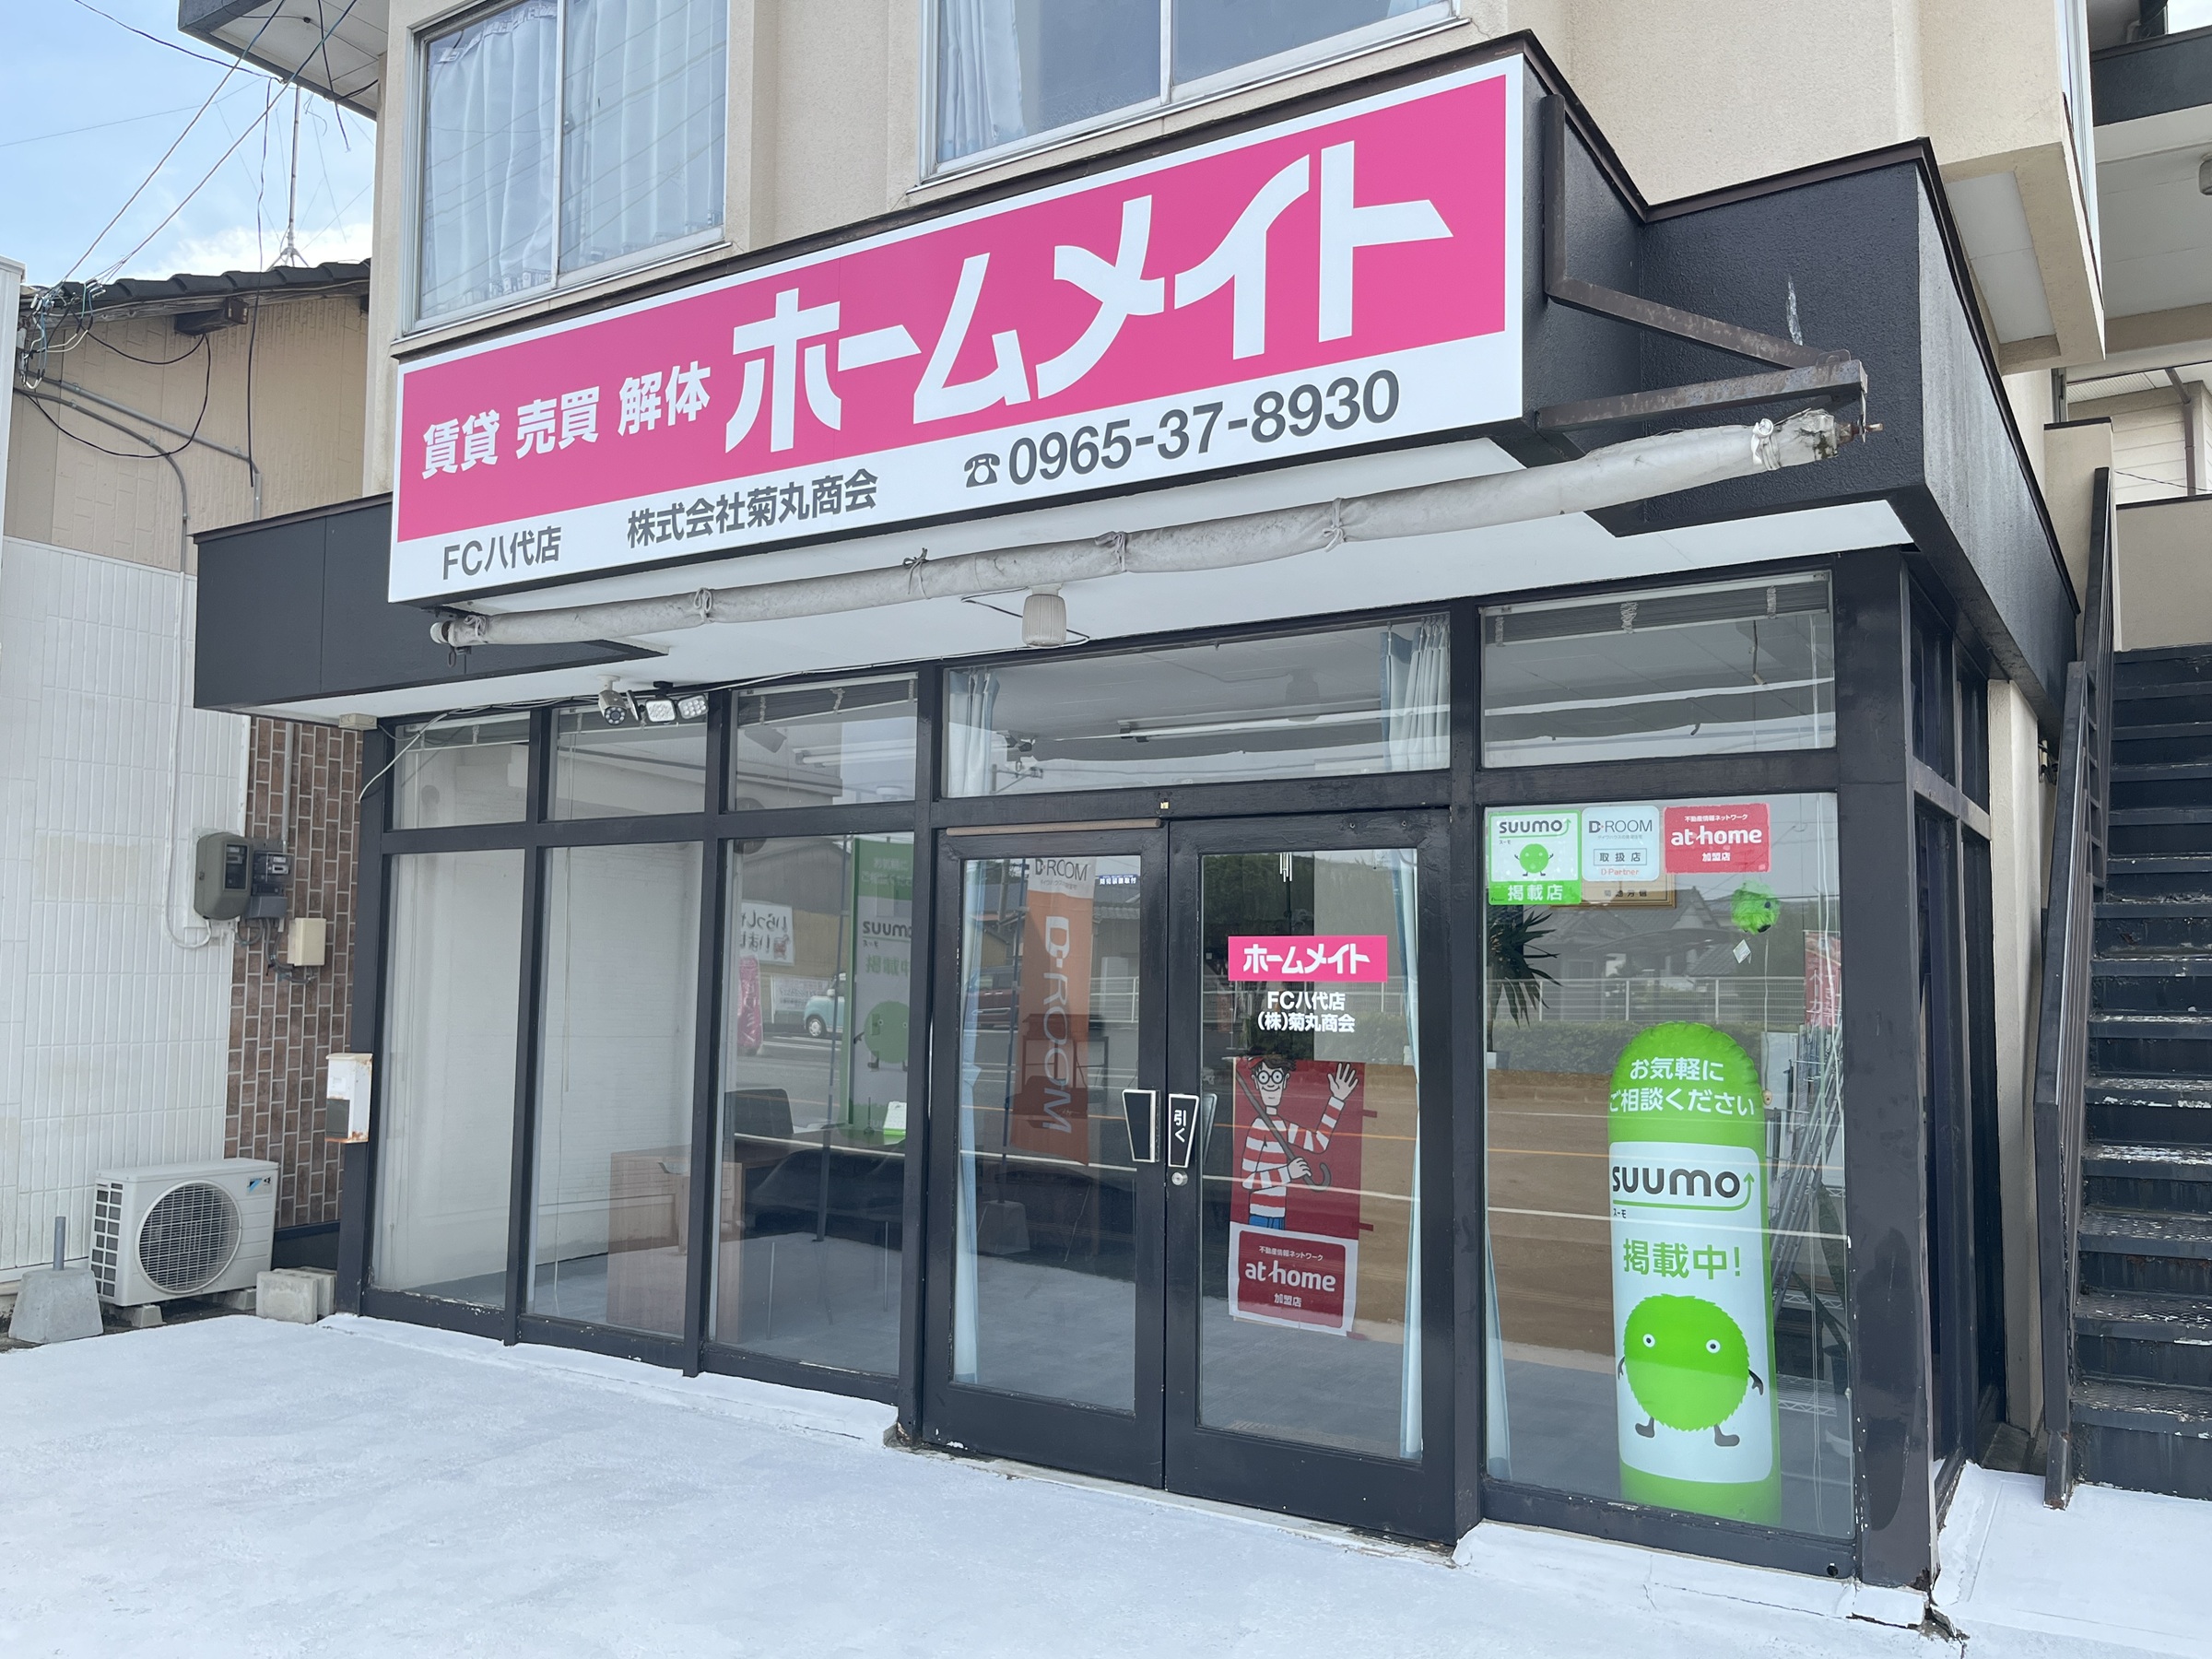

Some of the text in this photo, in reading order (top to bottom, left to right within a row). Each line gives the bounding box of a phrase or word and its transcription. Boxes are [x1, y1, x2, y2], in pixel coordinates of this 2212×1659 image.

[421, 140, 1453, 480] 賃貸 売買 解体 ホームメイト
[442, 369, 1400, 581] FC八代店 株式会社菊丸商会 0965-37-8930
[1684, 814, 1748, 823] 不動産情報ネットワーク
[1599, 853, 1641, 863] 取扱店
[1701, 853, 1731, 862] 加盟店
[1507, 883, 1564, 901] 掲載店
[1243, 944, 1371, 974] ホームメイト
[1267, 991, 1346, 1010] FC八代店
[1630, 1056, 1724, 1081] お気軽に
[1609, 1087, 1755, 1116] ご相談ください
[1173, 1109, 1187, 1143] 引く
[1258, 1245, 1324, 1262] 不動産情報ネットワーク
[1274, 1292, 1302, 1308] 加盟店
